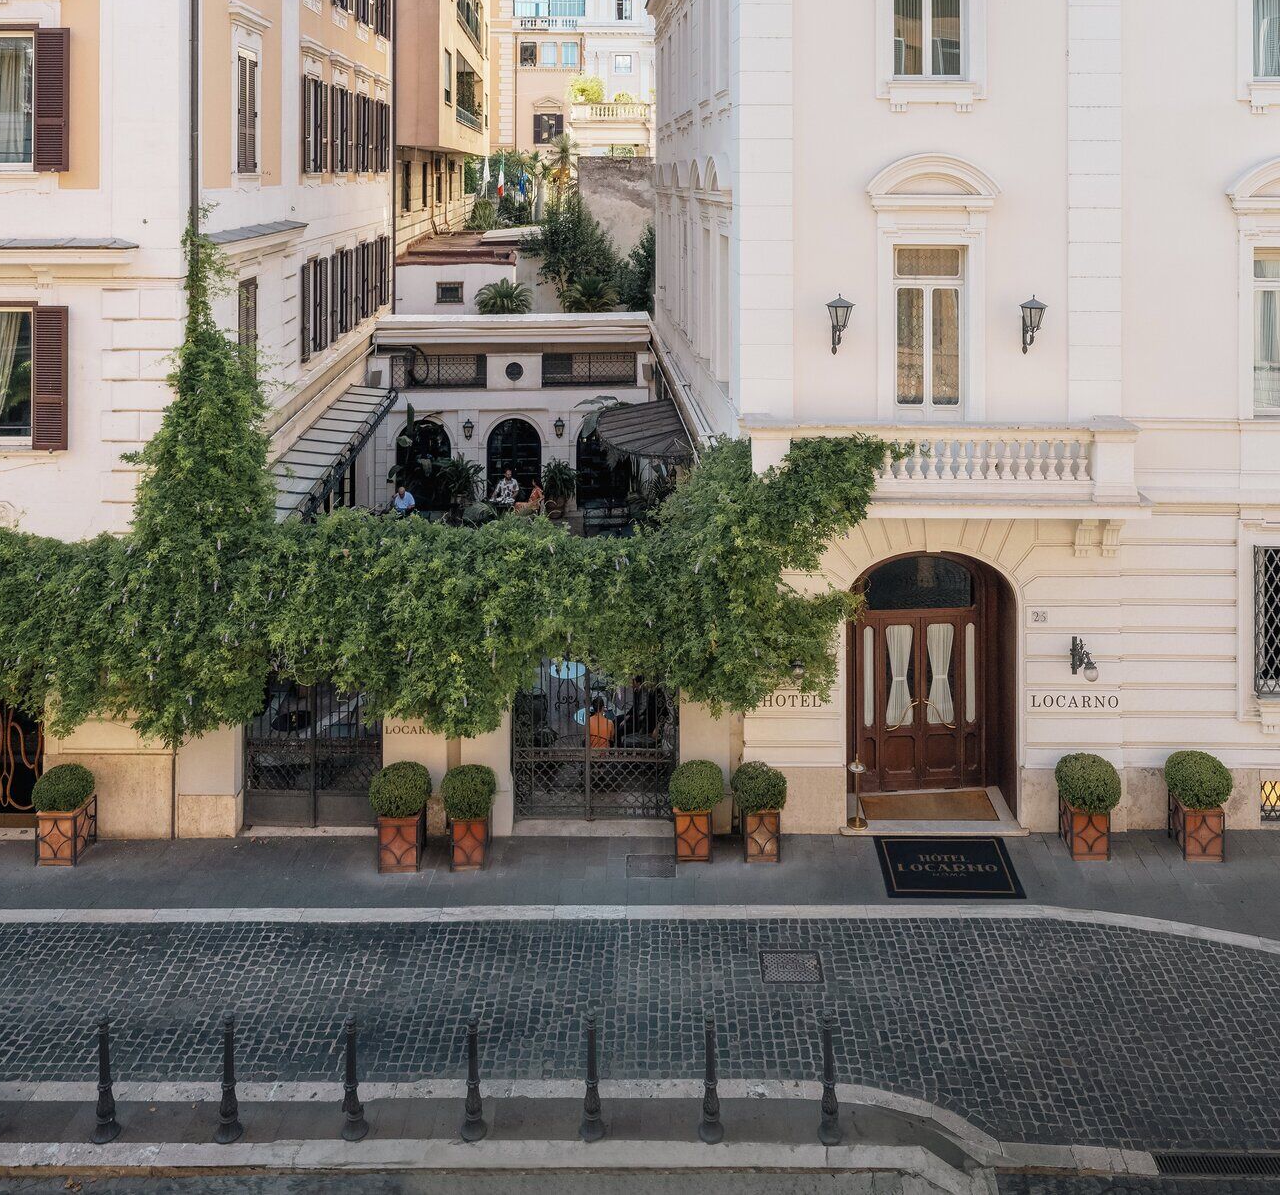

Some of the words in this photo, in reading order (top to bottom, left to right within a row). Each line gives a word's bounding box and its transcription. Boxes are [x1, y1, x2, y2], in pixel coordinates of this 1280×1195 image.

[762, 694, 822, 708] HOTEL
[1031, 694, 1119, 709] LOCARNO
[385, 725, 442, 735] LOCARN
